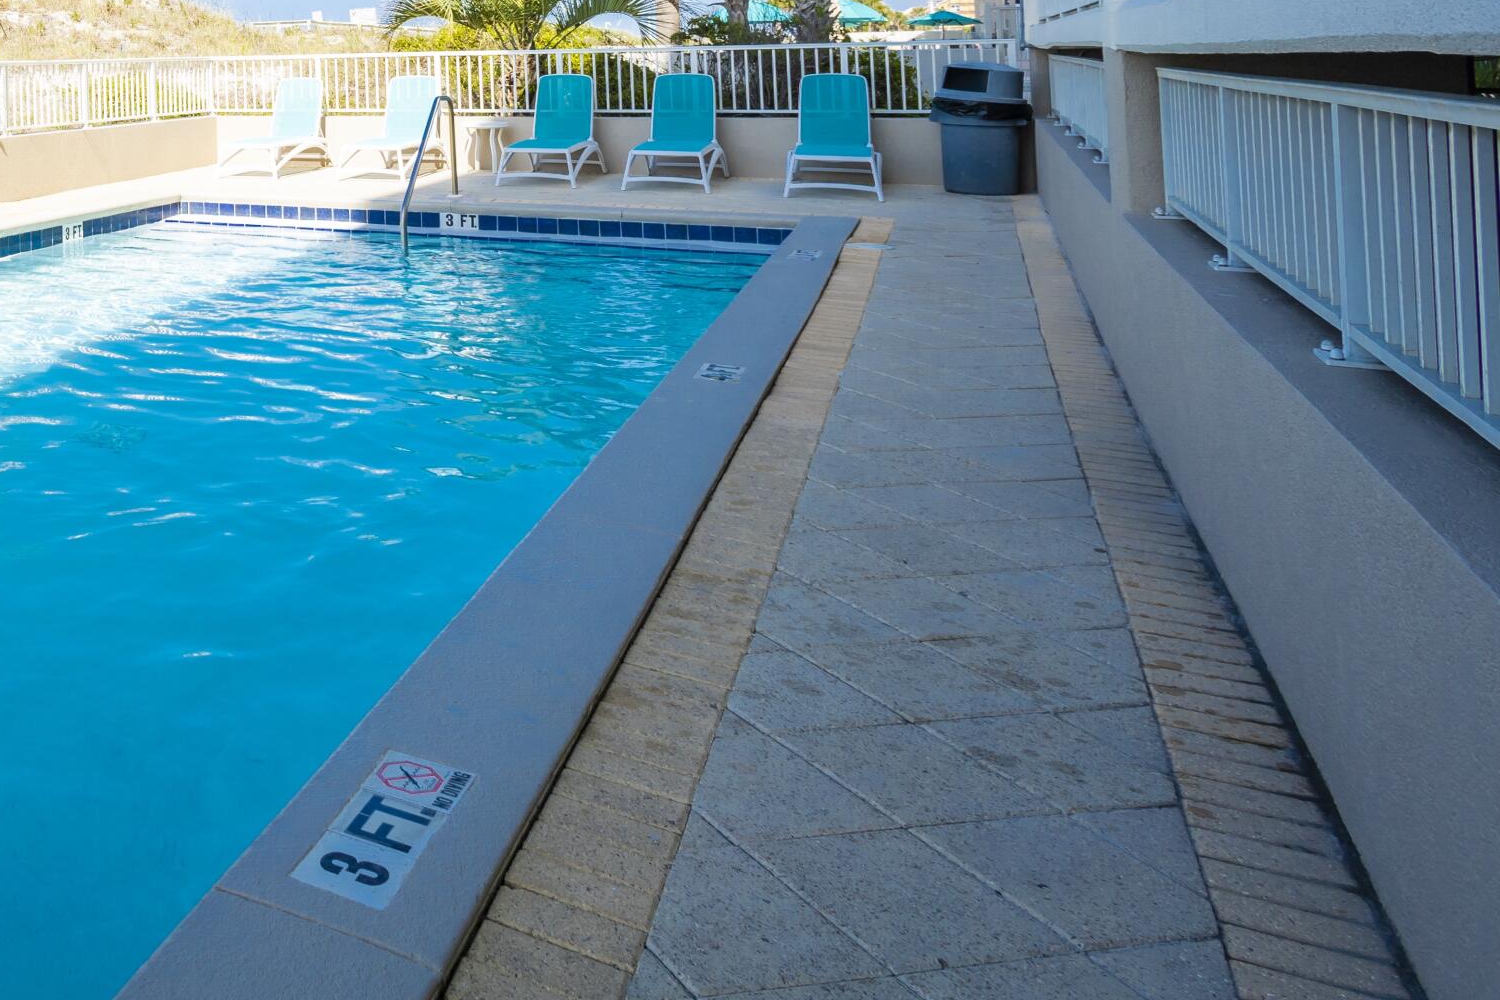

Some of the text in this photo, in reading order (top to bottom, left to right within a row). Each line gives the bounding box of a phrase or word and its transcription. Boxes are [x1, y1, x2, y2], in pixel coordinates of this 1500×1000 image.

[65, 227, 70, 240] 3
[445, 213, 477, 228] 3 FT.
[432, 770, 472, 811] NO DIVING
[320, 794, 438, 887] 3 FT.
